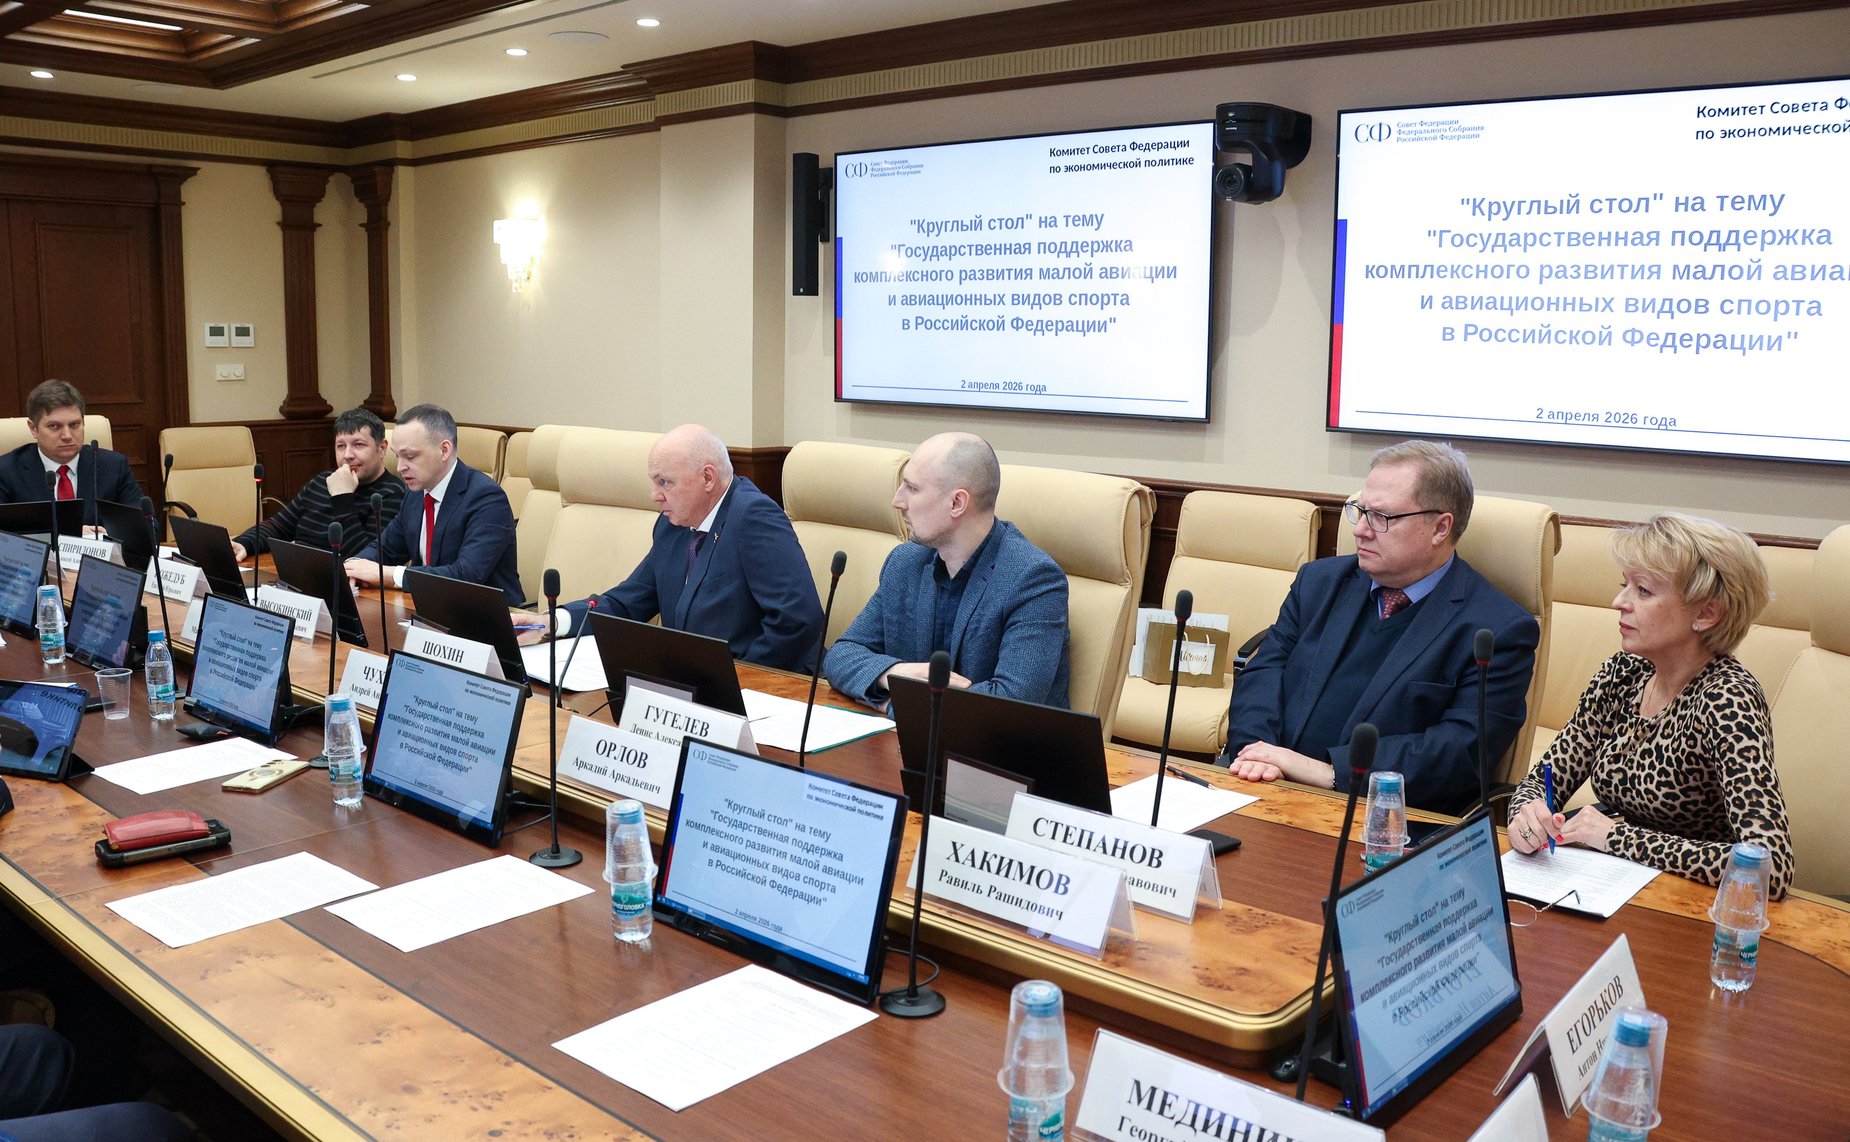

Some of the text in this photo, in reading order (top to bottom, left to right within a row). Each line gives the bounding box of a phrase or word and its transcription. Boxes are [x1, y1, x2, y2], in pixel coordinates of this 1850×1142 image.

[1698, 105, 1766, 118] Комитет
[1770, 102, 1828, 114] Совета
[1355, 123, 1392, 142] СФ
[1696, 130, 1714, 140] по
[1050, 140, 1190, 157] Комитет Совета Федерации
[845, 162, 868, 178] СФ
[1064, 158, 1141, 173] экономической
[1144, 157, 1194, 168] политике
[1462, 193, 1785, 221] "Круглый стол" на тему
[911, 214, 1104, 237] "Круглый стол" на тему
[892, 240, 1133, 262] "Государственная поддержка
[1428, 229, 1831, 253] "Государственная поддержка
[854, 270, 954, 283] комплексного
[959, 268, 1033, 285] развития
[1039, 262, 1093, 280] малой
[1366, 259, 1850, 285] комплексного развития малой авиа
[888, 293, 1130, 310] и авиационных видов спорта
[1421, 295, 1822, 322] и авиационных видов спорта
[902, 315, 1116, 337] в Российской Федерации"
[1442, 324, 1798, 356] в Российской Федерации"
[961, 380, 1047, 392] 2 апреля 2026 года
[1536, 408, 1676, 426] 2 апреля 2026 года
[422, 641, 464, 664] ШОХИН
[644, 704, 710, 738] ГУГЕЛЕВ
[596, 738, 648, 769] ОРЛОВ
[572, 756, 661, 794] Аркадий Аркадьевич
[724, 799, 832, 843] "Круглый стол" на тему
[711, 810, 843, 862] "Государственная поддержка
[1032, 817, 1164, 869] СТЕПАНОВ
[686, 819, 864, 886] комплексного развития малой авиации
[702, 841, 836, 894] и авиационных видов спорта
[946, 840, 1070, 896] ХАКИМОВ
[708, 859, 827, 906] в Российской Федерации"
[938, 869, 1064, 920] Равиль Рашидович
[1566, 975, 1624, 1056] ЕГОРЬКОВ
[1127, 1078, 1302, 1142] МЕДИН
